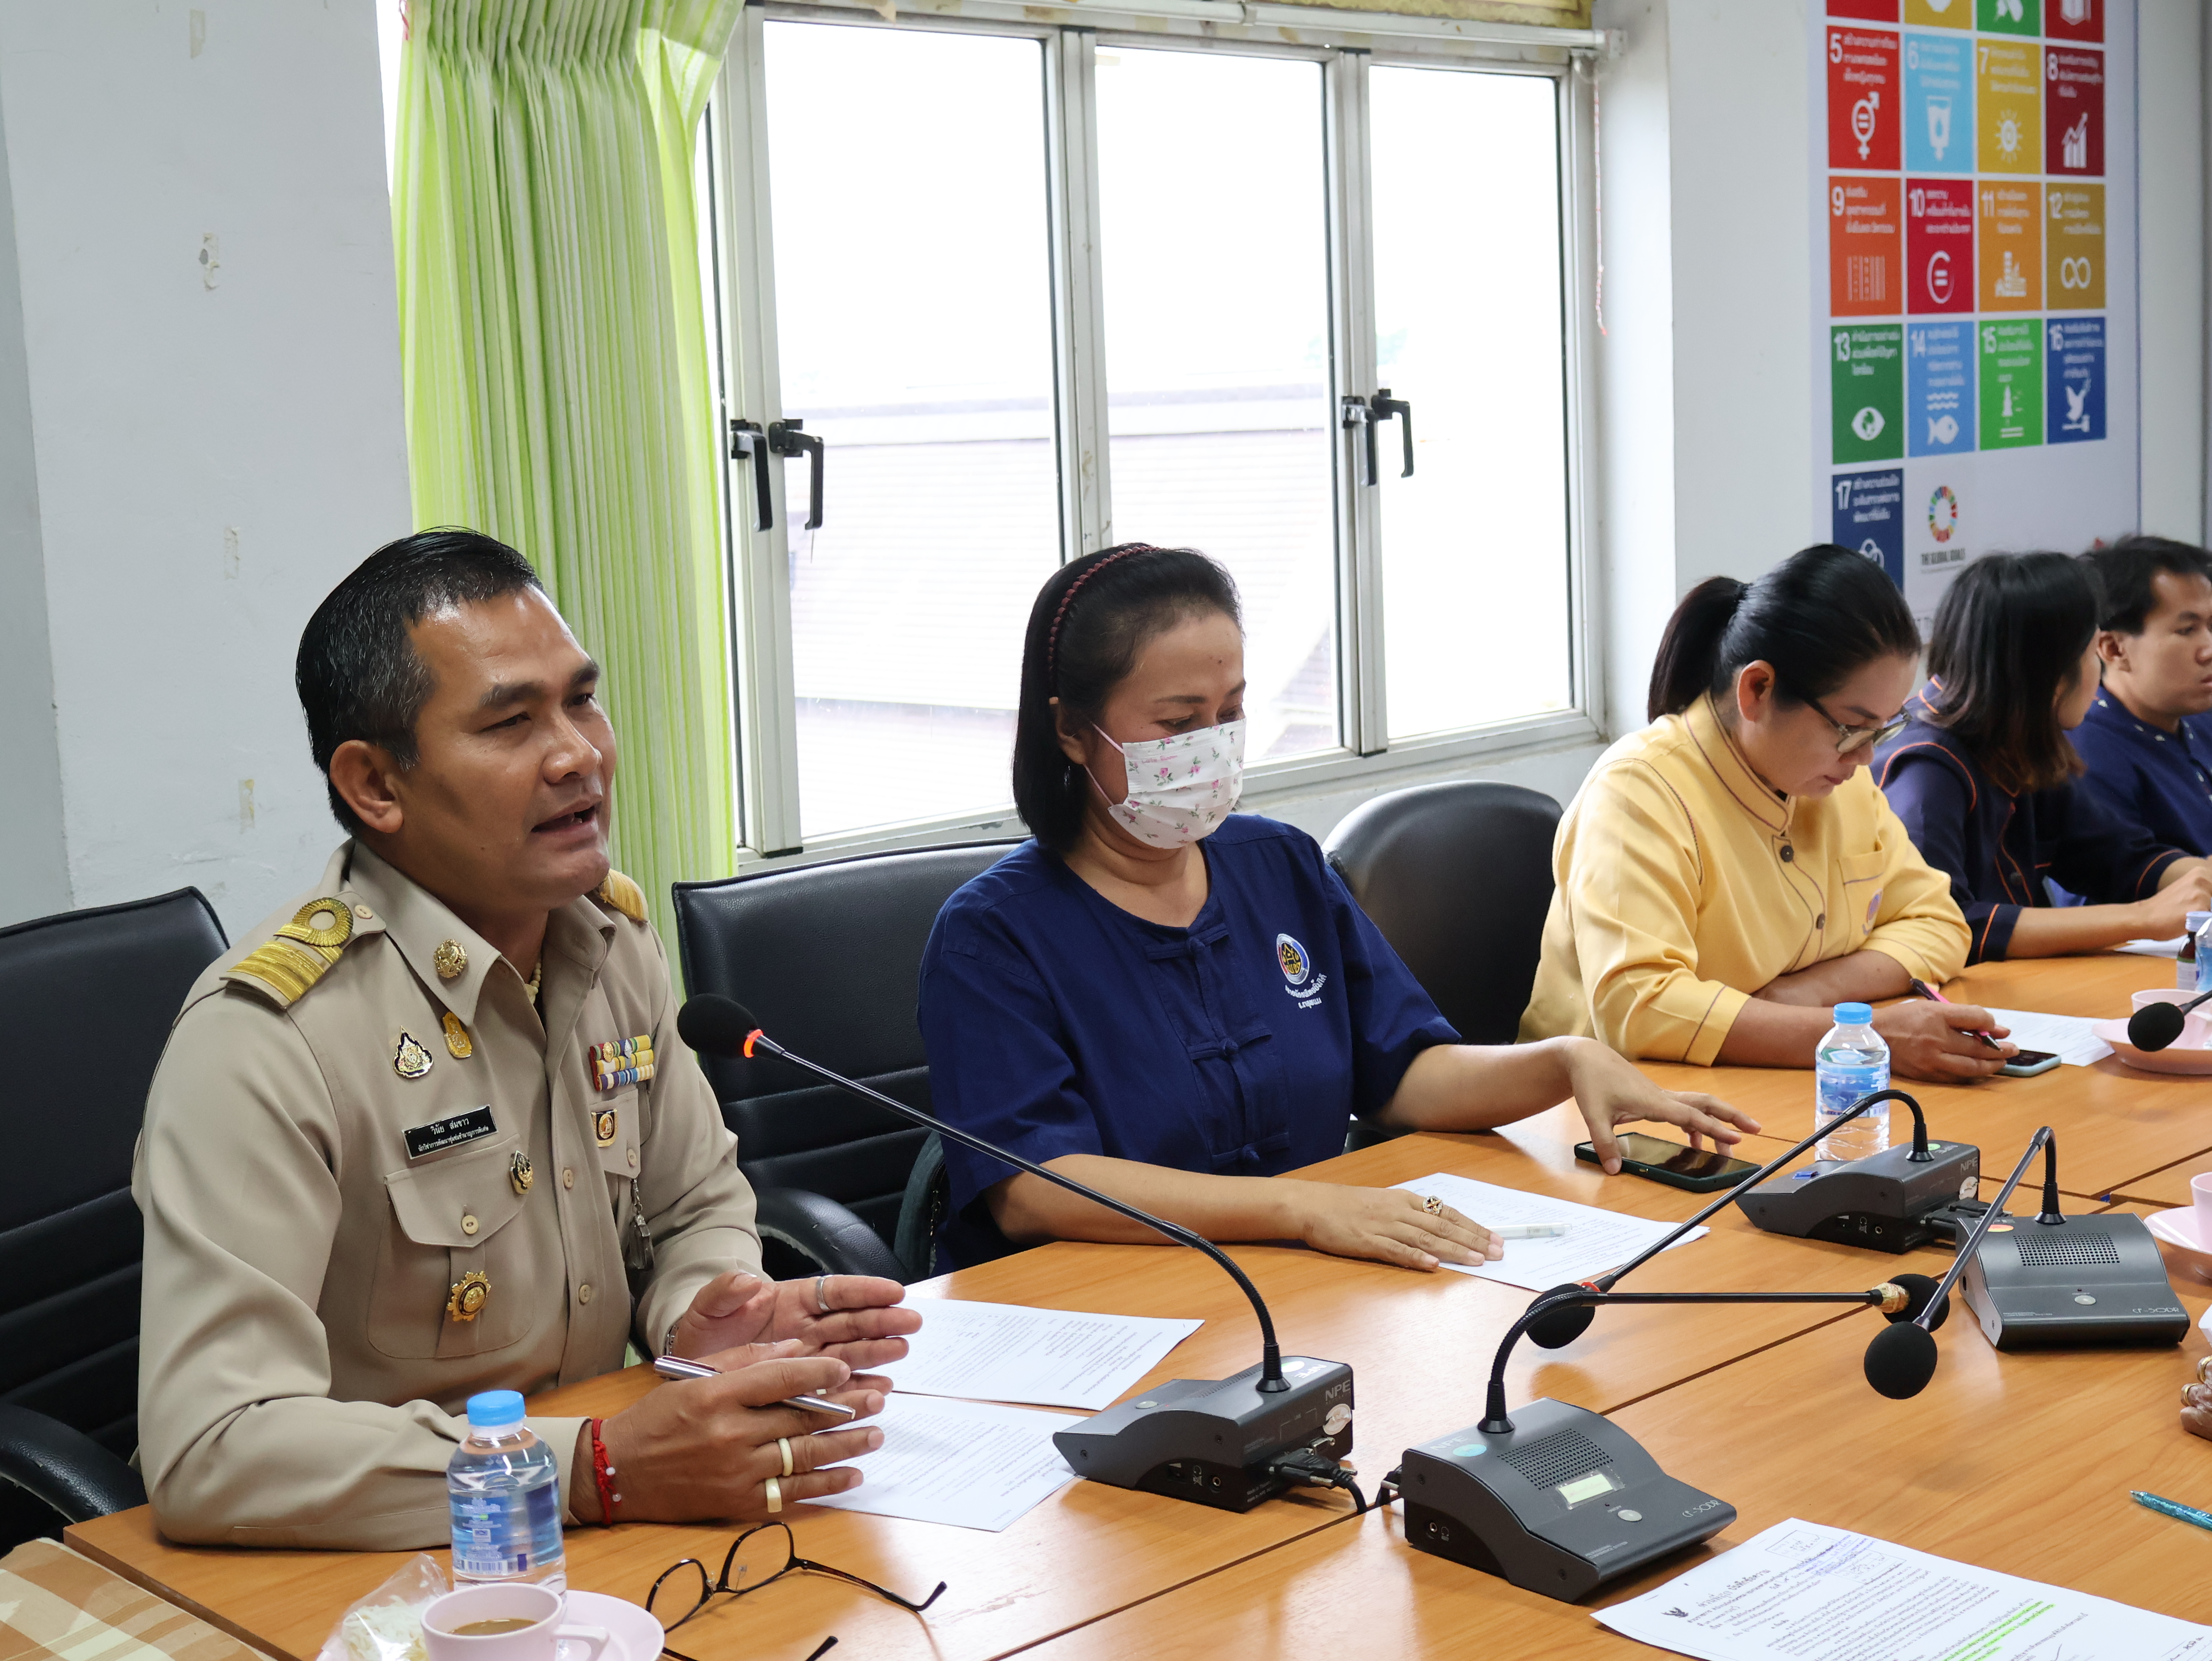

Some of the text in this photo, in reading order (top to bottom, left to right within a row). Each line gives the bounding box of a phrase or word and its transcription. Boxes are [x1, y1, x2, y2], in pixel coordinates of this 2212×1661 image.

[1829, 33, 1842, 63] 5
[1909, 42, 1919, 70] 6
[1979, 47, 1990, 74] 7
[2047, 53, 2058, 81] 8
[1832, 186, 1845, 216] 9
[1909, 188, 1925, 217] 10
[1981, 191, 1994, 218] 11
[2048, 192, 2063, 219] 12
[1834, 332, 1850, 361] 13
[1911, 330, 1926, 358] 14
[1982, 326, 1997, 353] 15
[2048, 324, 2063, 351] 16
[1836, 480, 1852, 510] 17
[430, 1124, 445, 1135] วินัย
[1960, 1157, 1978, 1172] NPE
[1294, 1364, 1327, 1379] NPE
[1325, 1379, 1351, 1400] NPE
[1429, 1436, 1466, 1451] NPE
[1682, 1500, 1722, 1517] CF-50DR
[1696, 1569, 1771, 1607] ด่วนที่สุด บันทึกข้อความ
